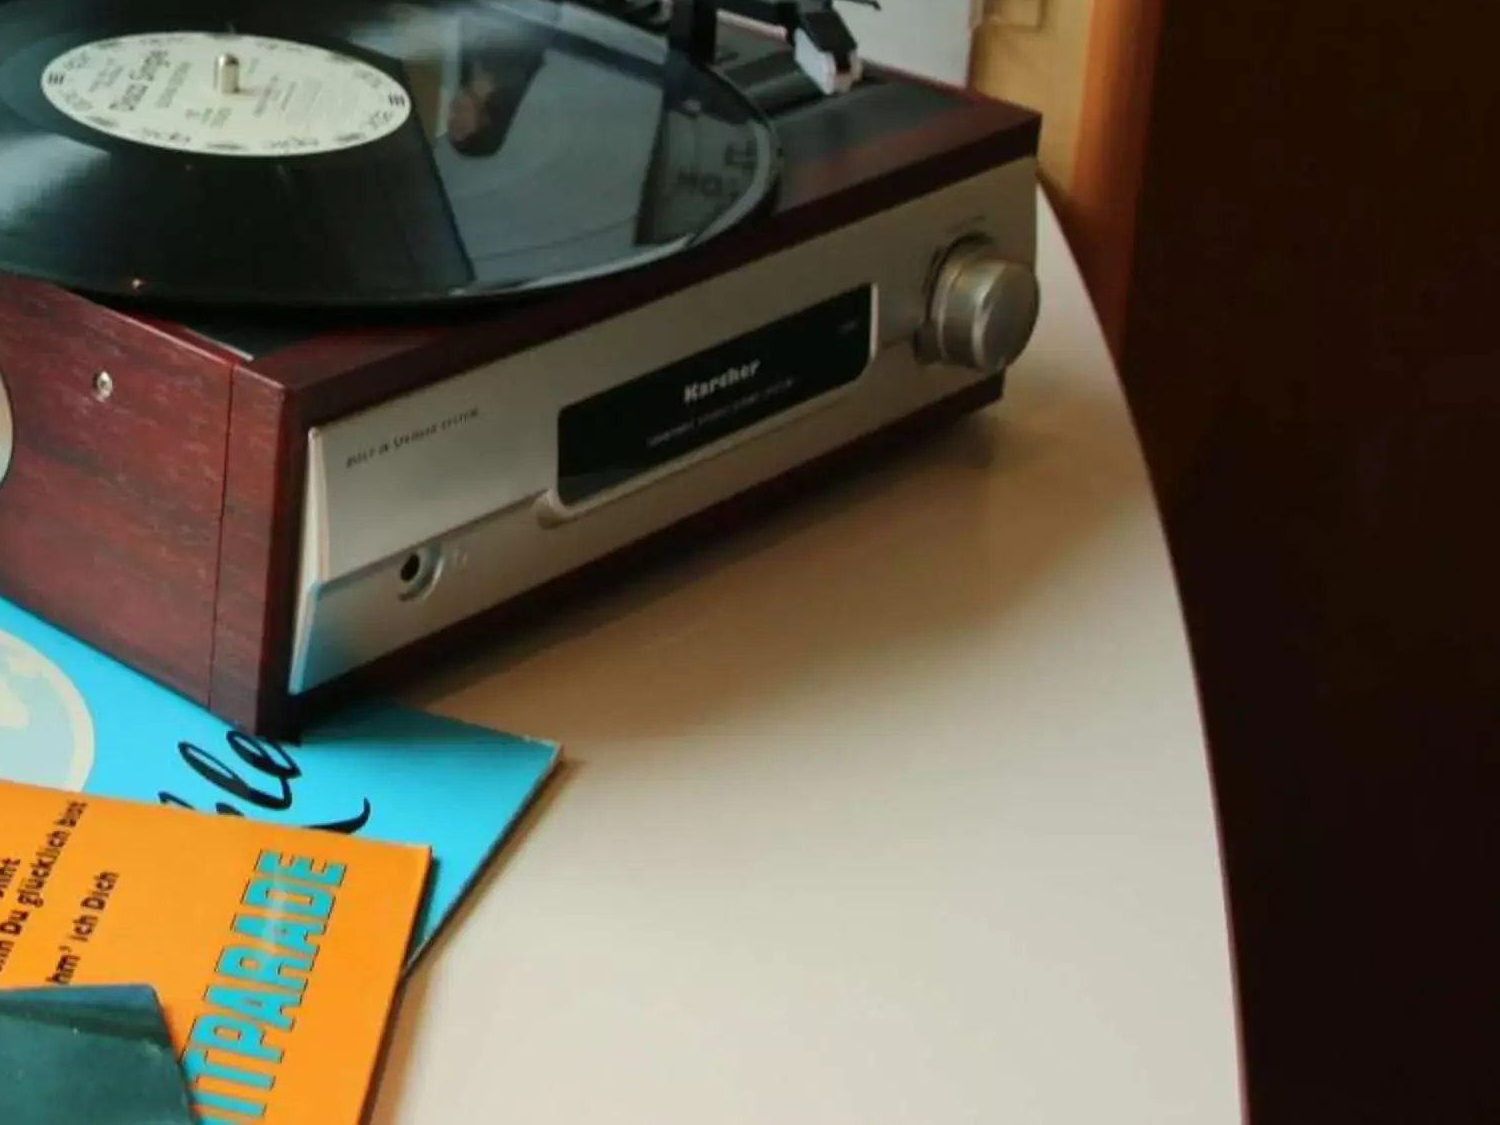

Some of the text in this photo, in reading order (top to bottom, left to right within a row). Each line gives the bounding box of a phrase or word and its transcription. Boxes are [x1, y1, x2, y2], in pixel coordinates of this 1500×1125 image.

[45, 871, 120, 985] hm' ich Dich
[181, 848, 348, 1125] ITPARADE
